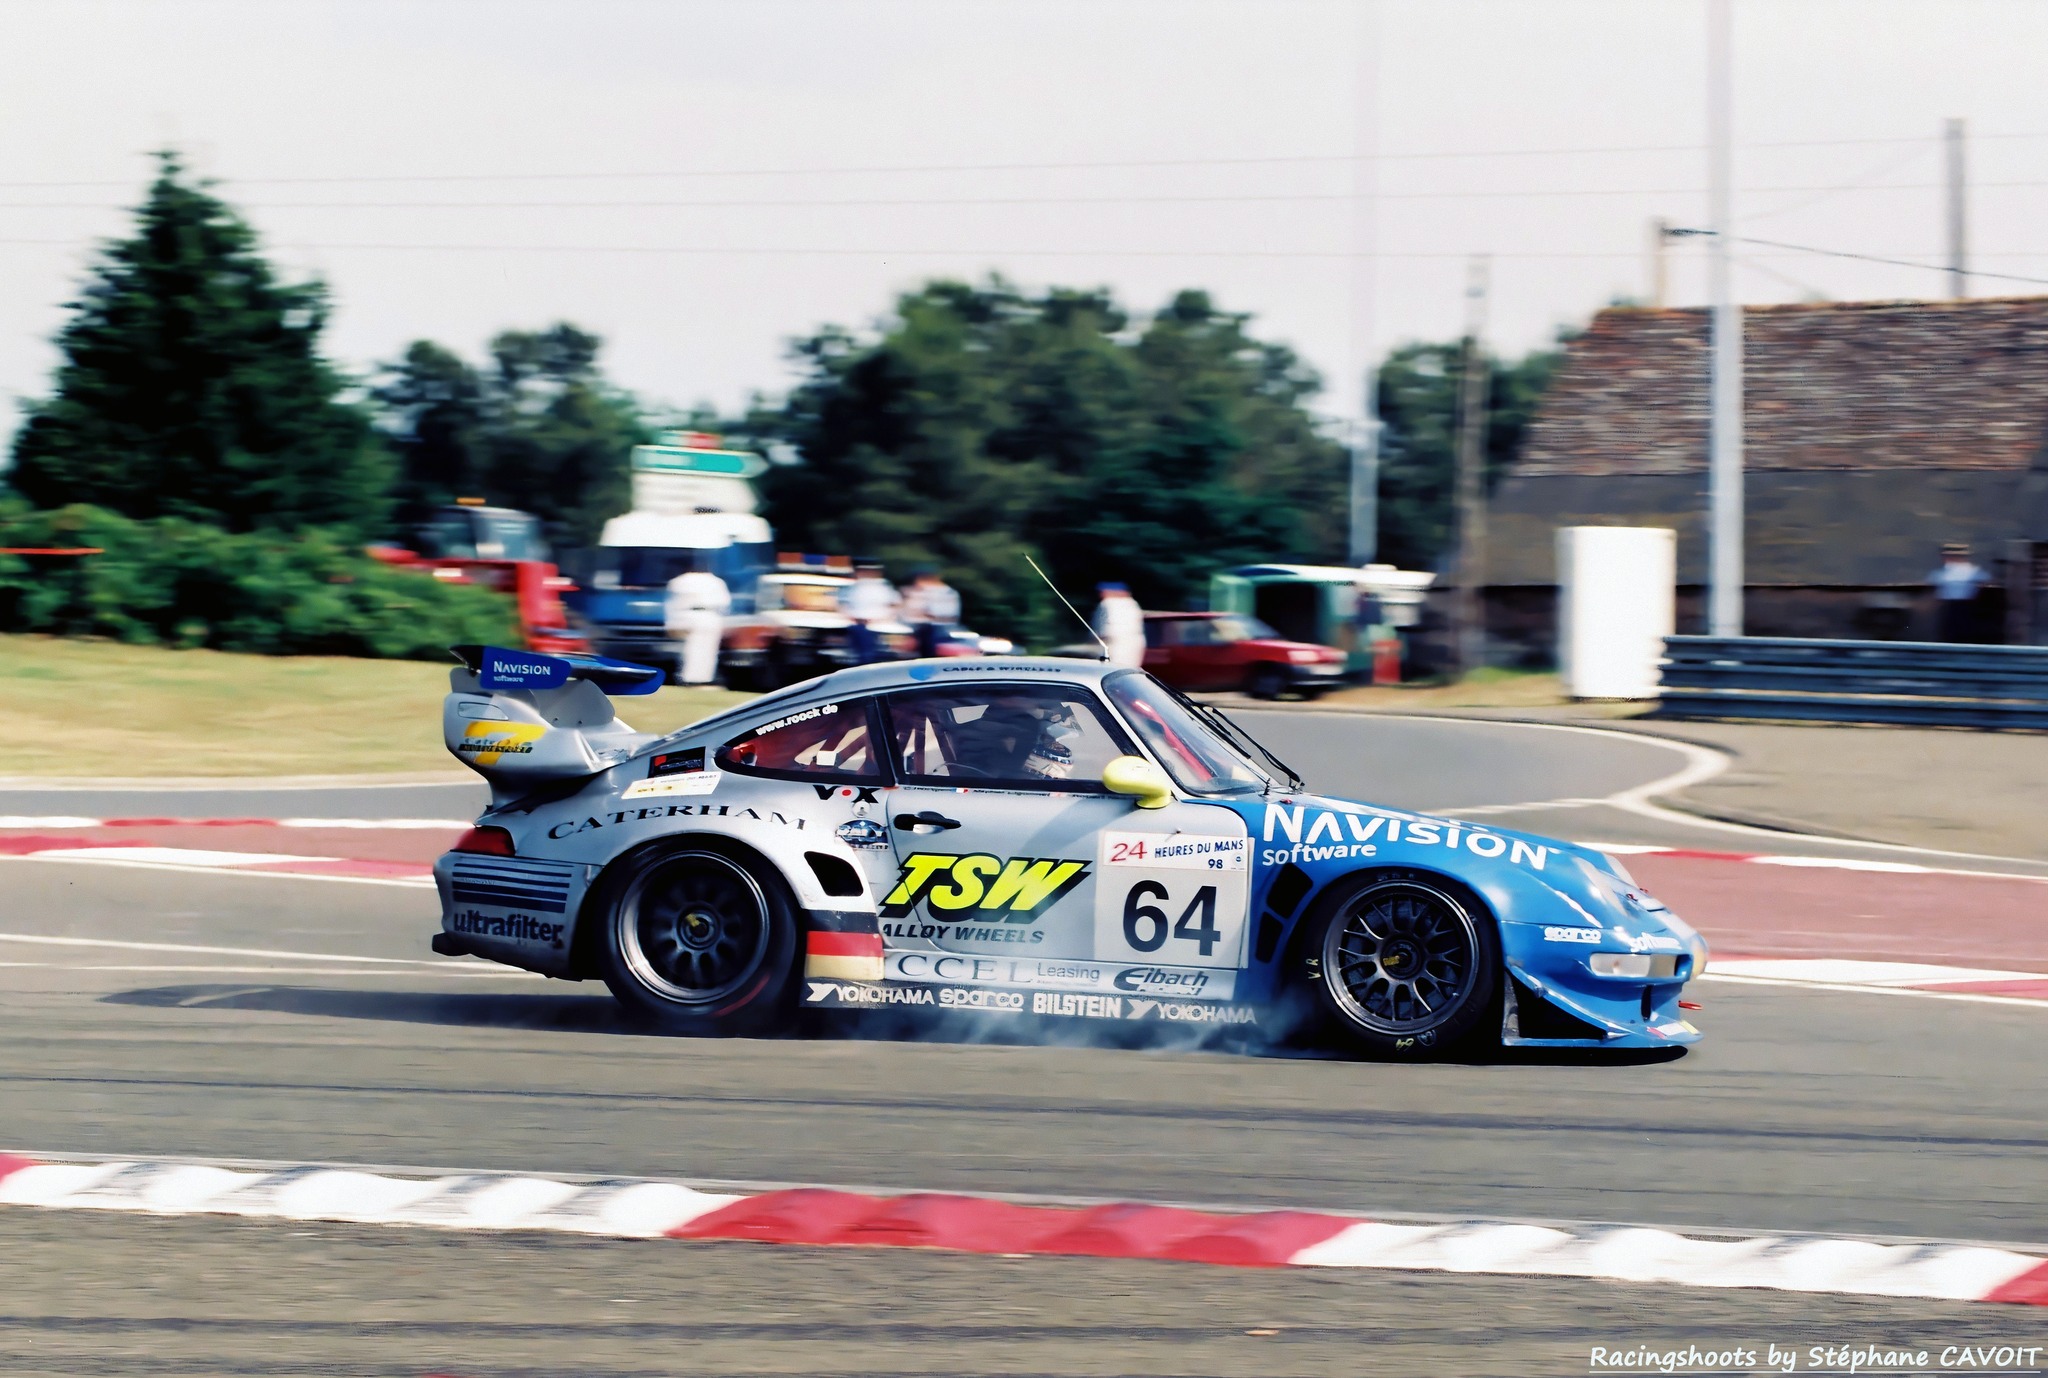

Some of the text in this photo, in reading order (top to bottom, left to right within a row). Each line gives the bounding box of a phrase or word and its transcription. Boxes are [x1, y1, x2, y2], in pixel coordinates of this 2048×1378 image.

[494, 661, 551, 675] NAVISION
[494, 675, 524, 683] software
[548, 804, 807, 839] CATERHAM
[1111, 839, 1244, 862] 24 HEURES DU MANS
[1263, 803, 1548, 871] NAVISION
[1208, 858, 1223, 869] 98
[1262, 841, 1377, 866] software
[878, 852, 1093, 924] TSW
[454, 910, 565, 943] ultrafilter
[1123, 880, 1221, 957] 64
[882, 923, 1045, 944] ALLOY WHEELS
[1037, 962, 1100, 983] Leasing
[1113, 968, 1209, 991] Eibach
[836, 985, 1257, 1024] YOKOHAMA sparco BILSTEIN YOKOHAMA
